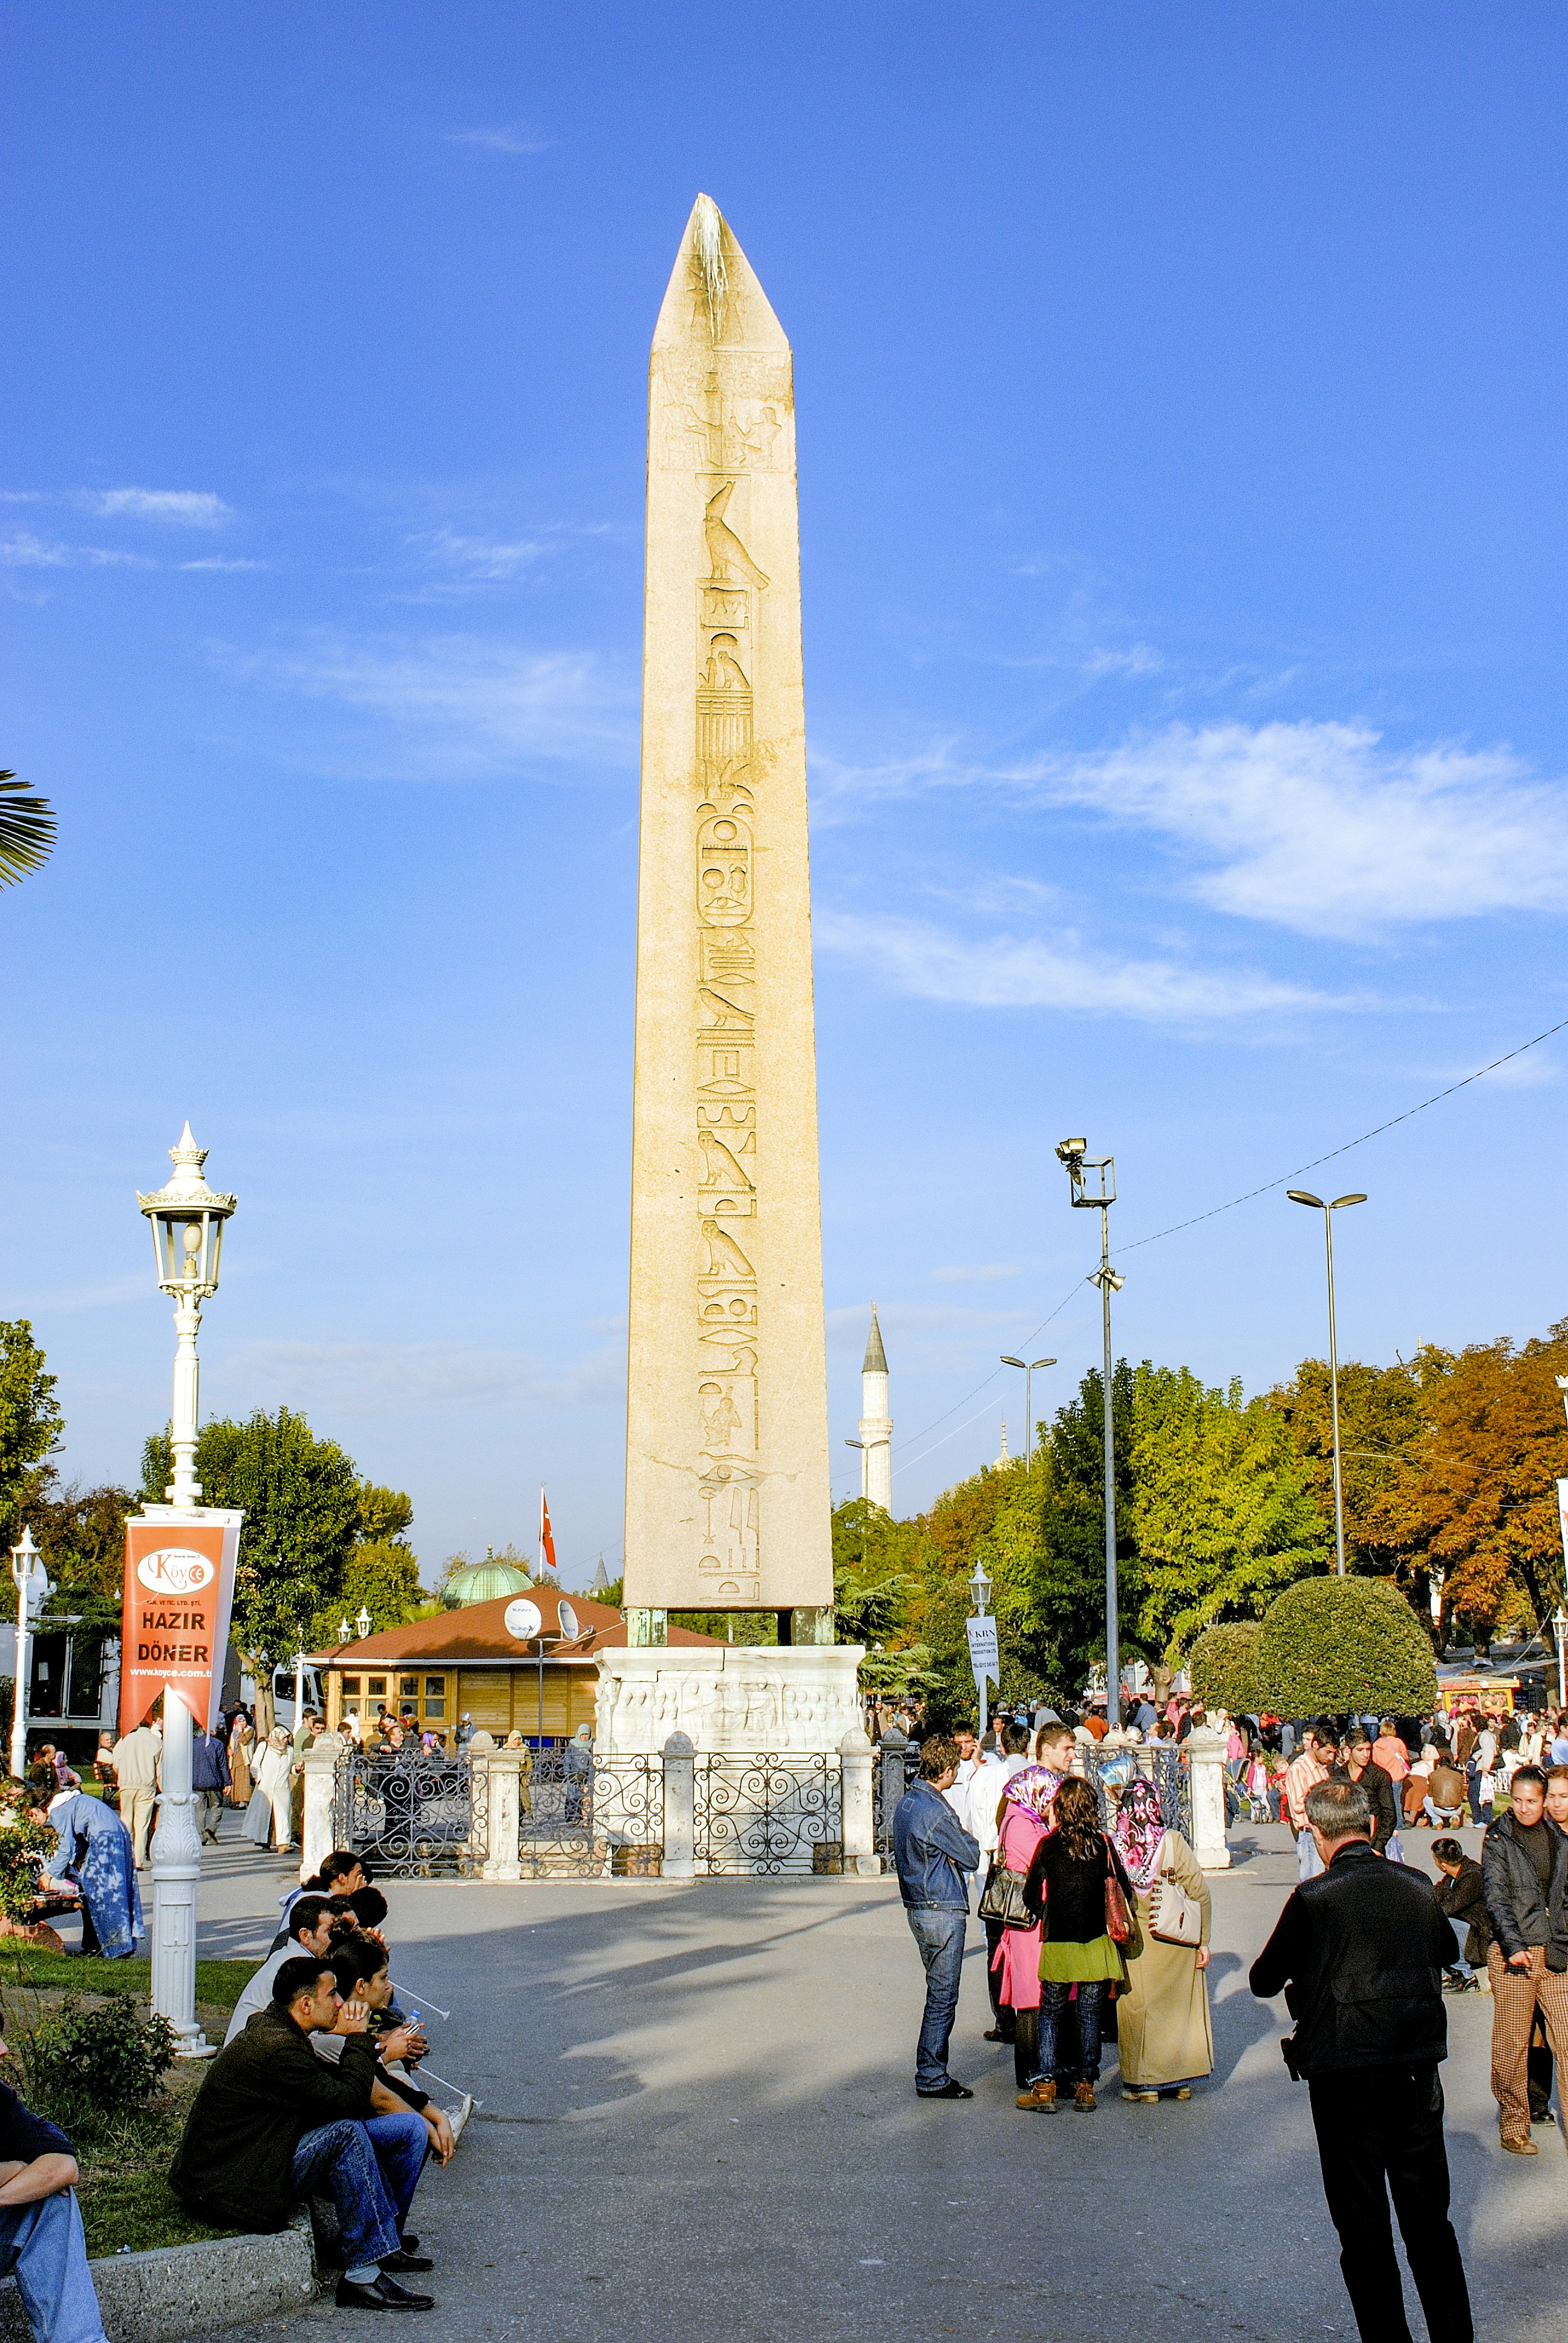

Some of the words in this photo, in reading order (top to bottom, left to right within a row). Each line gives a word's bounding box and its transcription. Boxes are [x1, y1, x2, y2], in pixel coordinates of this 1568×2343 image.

[143, 1612, 206, 1630] HAZIR
[975, 1629, 996, 1638] KRN
[138, 1640, 209, 1662] DÖNER
